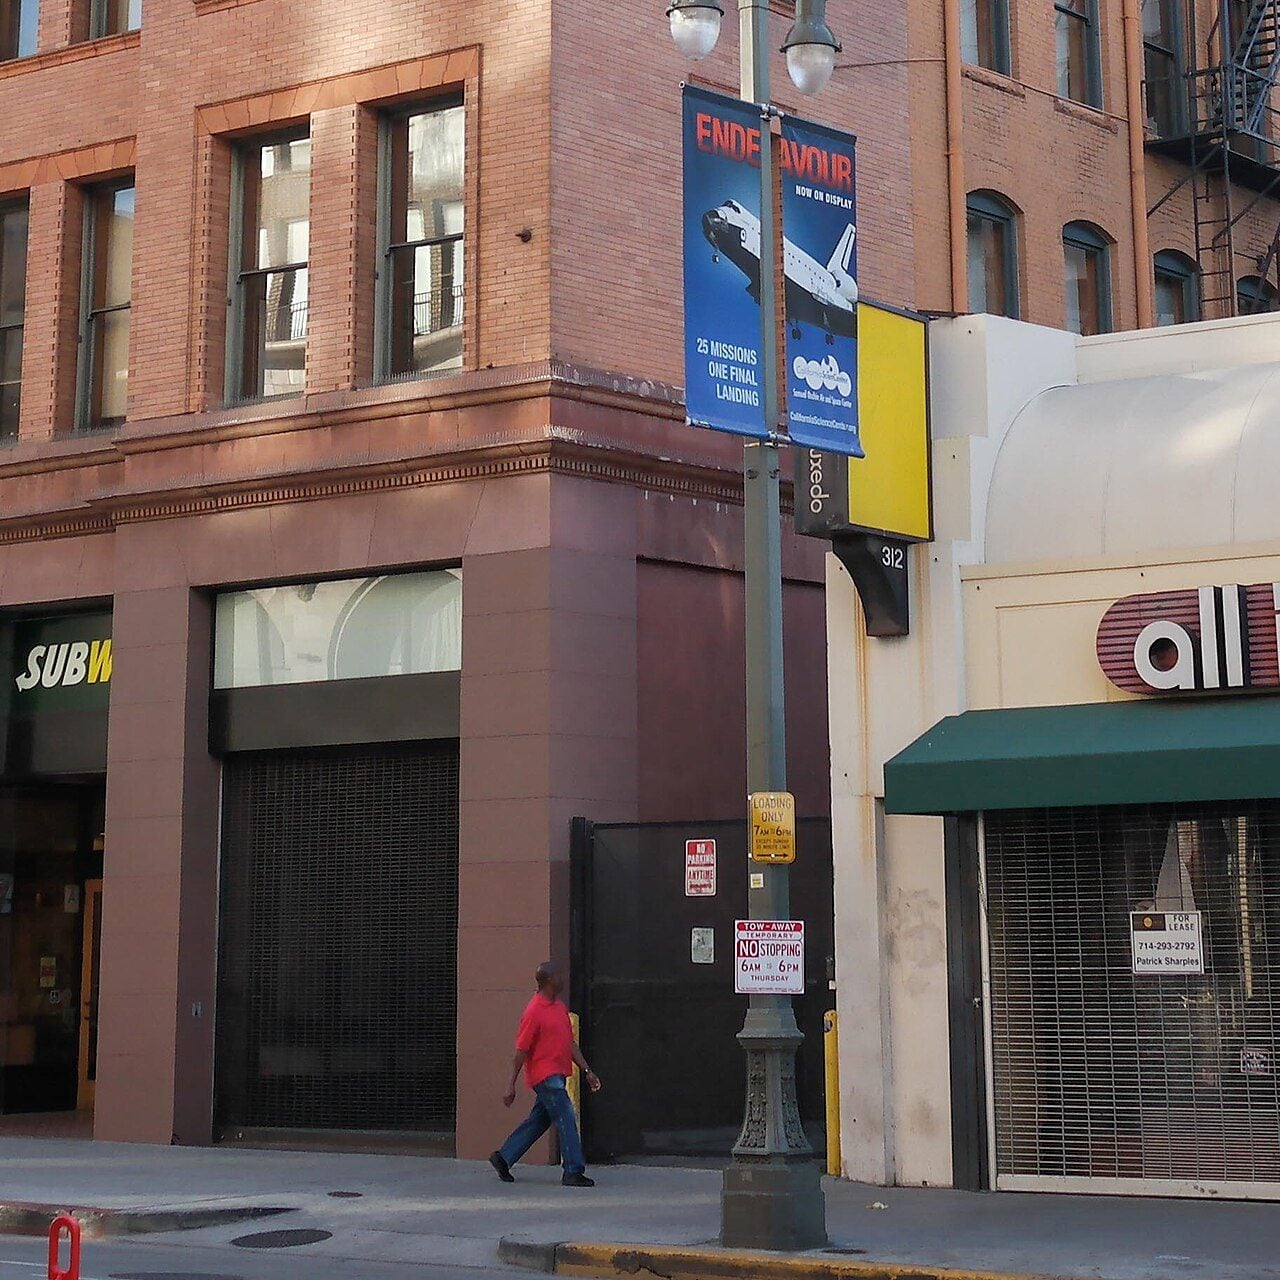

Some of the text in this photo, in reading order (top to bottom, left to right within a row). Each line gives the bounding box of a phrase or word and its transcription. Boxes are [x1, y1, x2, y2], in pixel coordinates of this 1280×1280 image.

[795, 185, 853, 210] NOW ON DISPLAY
[697, 337, 757, 365] 25 MISSIONS
[708, 361, 758, 387] ONE FINAL
[716, 383, 759, 407] LANDING
[809, 449, 830, 514] uxedo
[882, 545, 904, 569] 312
[1133, 583, 1246, 691] all
[15, 639, 112, 692] SUBW
[754, 798, 791, 809] LOADING
[761, 811, 784, 822] ONLY
[696, 844, 705, 854] NO
[687, 854, 714, 865] PARKING
[688, 870, 713, 880] ANYTIME
[1169, 923, 1194, 931] LEASE
[739, 940, 800, 956] NO STOPPING
[1139, 942, 1195, 950] 714-293-2792
[741, 959, 761, 972] 6AM
[778, 959, 799, 972] 6PM
[1136, 957, 1199, 966] Patrick Sharples
